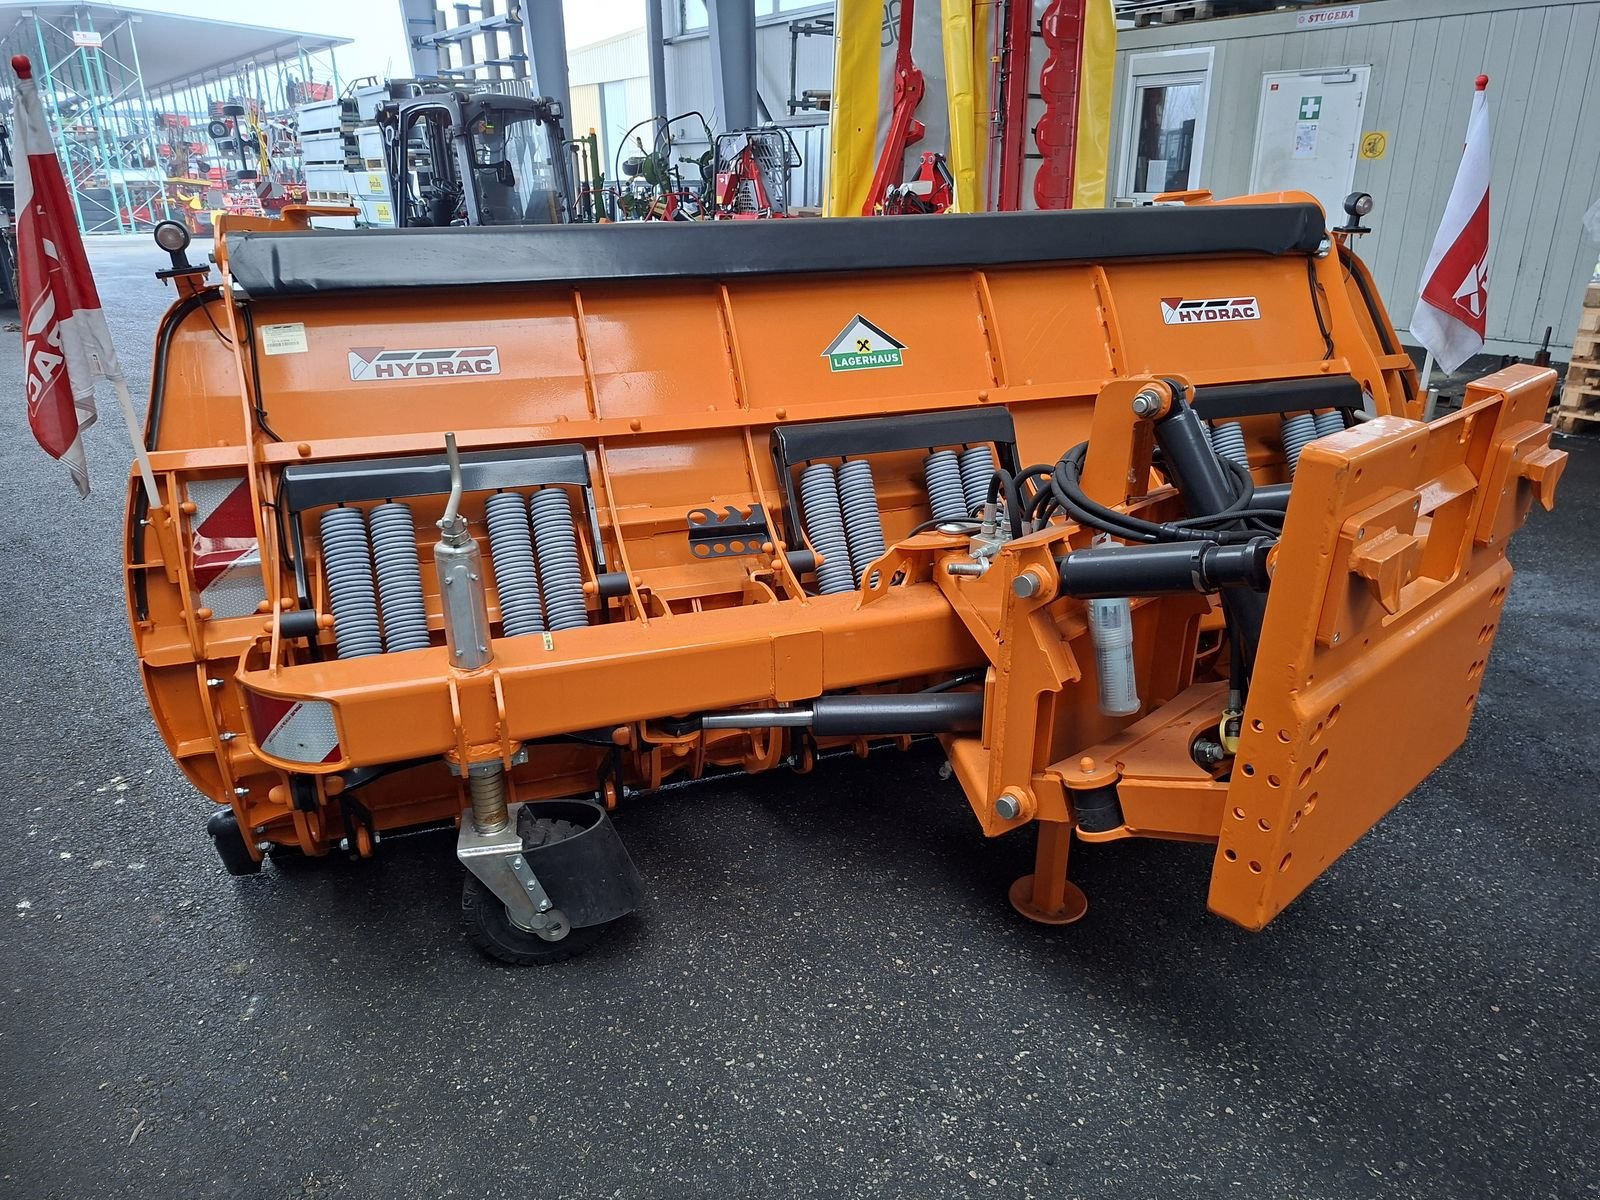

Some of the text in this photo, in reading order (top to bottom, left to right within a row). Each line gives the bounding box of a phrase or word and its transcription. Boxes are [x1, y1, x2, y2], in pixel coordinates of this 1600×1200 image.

[1308, 10, 1354, 23] STUGEBA
[1179, 307, 1255, 321] HYDRAC
[834, 353, 899, 367] LAGERHAUS
[375, 359, 493, 378] HYDRAC
